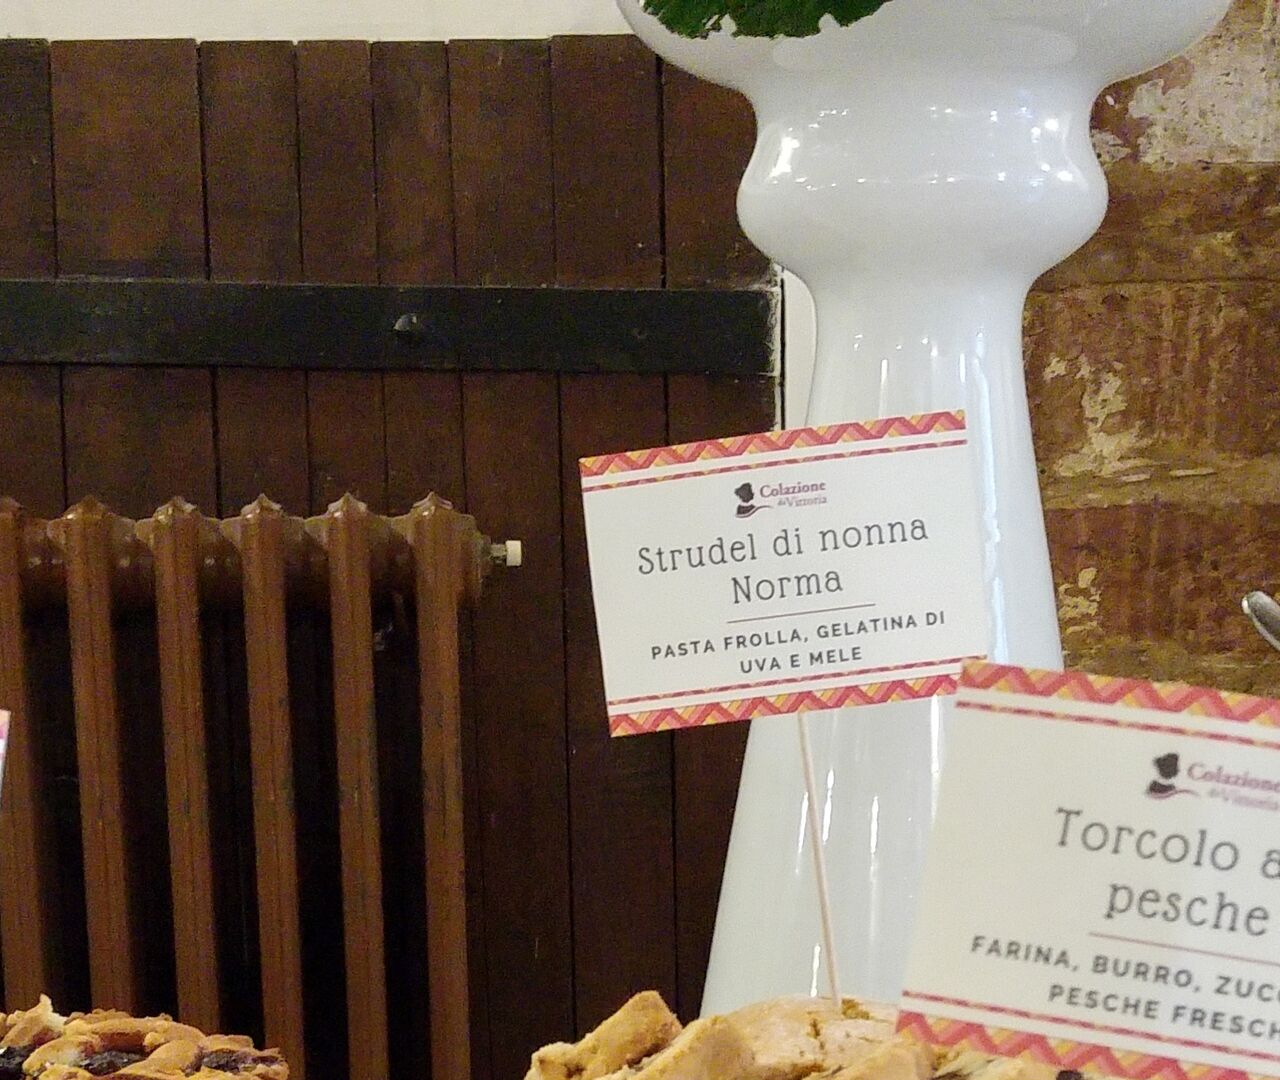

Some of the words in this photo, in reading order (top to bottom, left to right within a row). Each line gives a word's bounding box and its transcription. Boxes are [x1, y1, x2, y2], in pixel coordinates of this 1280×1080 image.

[759, 481, 827, 498] Colazione
[639, 533, 757, 575] Strudel
[773, 528, 803, 557] di
[819, 519, 928, 551] nonna
[731, 571, 843, 604] Norma
[651, 640, 715, 659] PASTA
[724, 629, 808, 650] FROLLA,
[817, 615, 917, 638] GELATINA
[926, 611, 944, 626] DI
[740, 657, 781, 674] UVA
[790, 654, 800, 668] E
[809, 646, 862, 665] MELE
[1056, 807, 1240, 871] Torcolo
[1104, 884, 1270, 936] pesche
[971, 935, 1078, 972] FARINA,
[1091, 955, 1200, 992] BURRO,
[1049, 984, 1160, 1020] PESCHE
